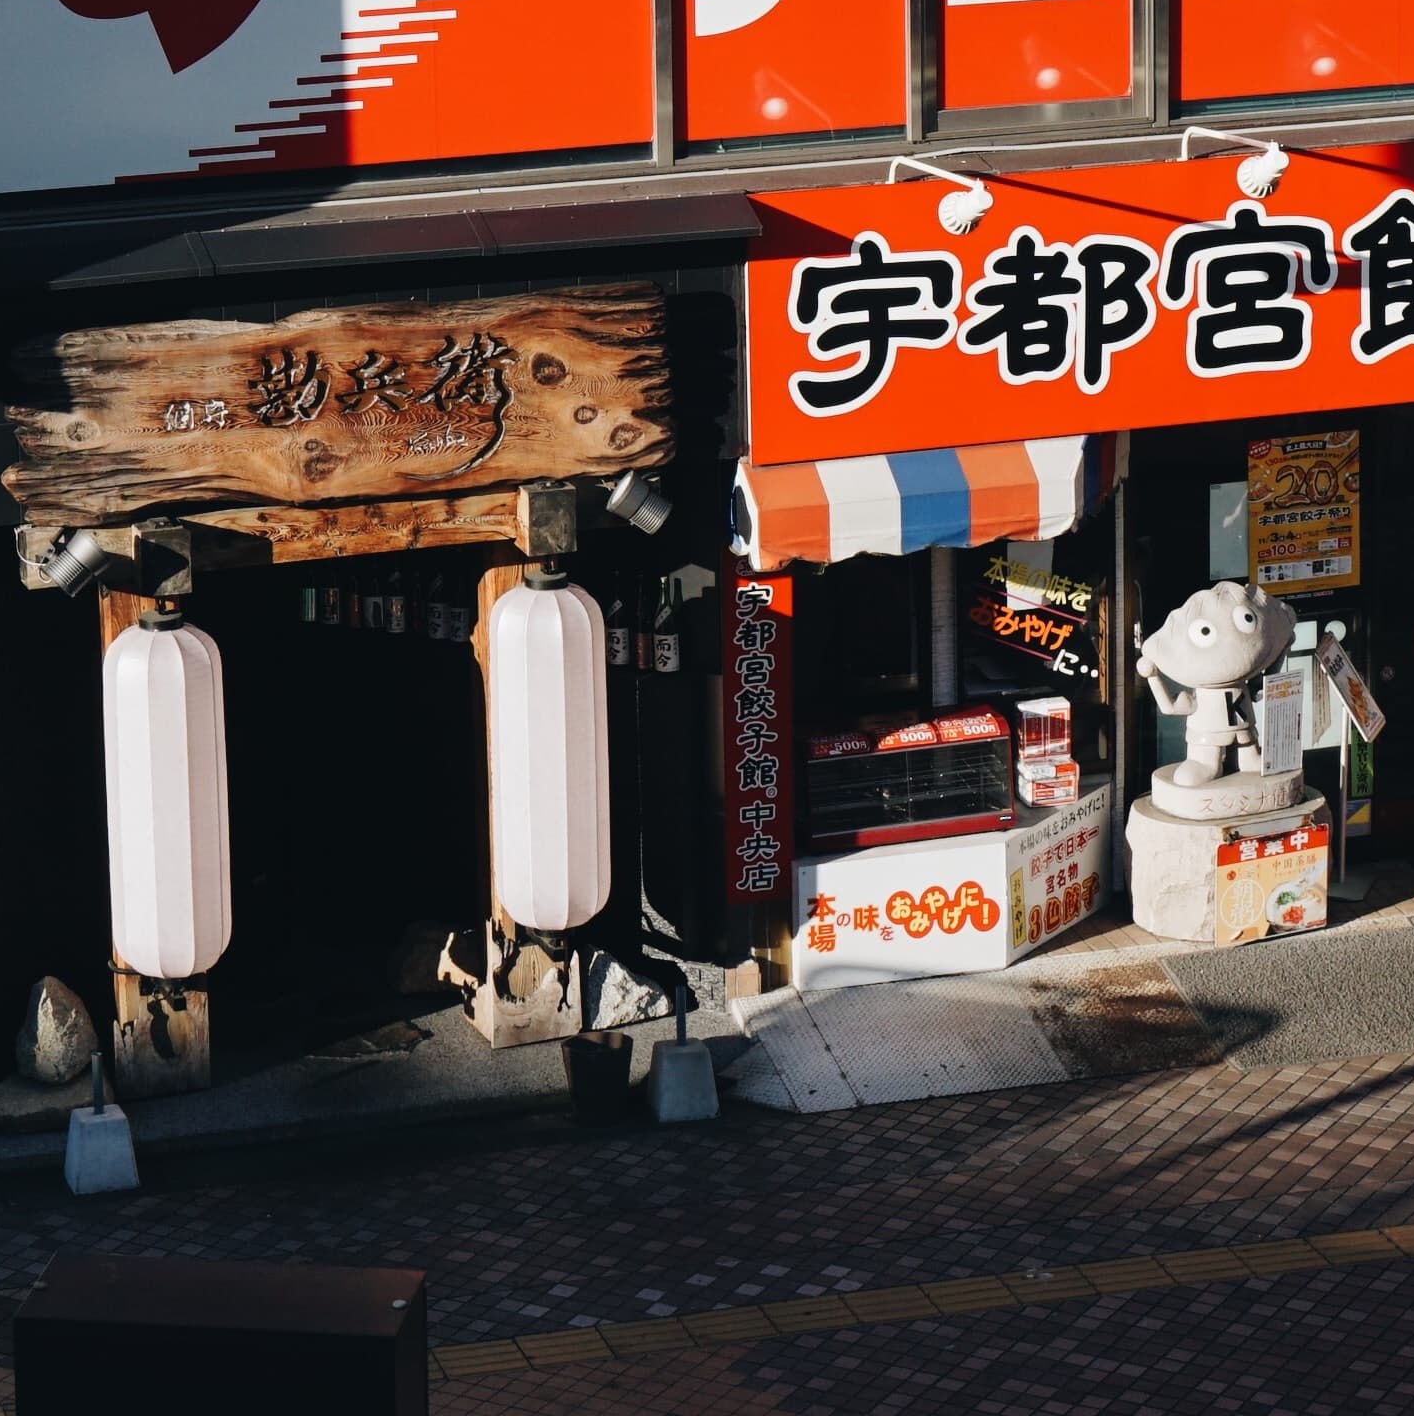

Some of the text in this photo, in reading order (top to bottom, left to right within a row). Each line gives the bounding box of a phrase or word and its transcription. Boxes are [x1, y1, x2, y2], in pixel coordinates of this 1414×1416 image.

[1259, 507, 1351, 526] 宇都宮餃子祭り
[1225, 691, 1248, 727] K
[736, 585, 779, 892] 宇都宮餃子館 中央店
[1239, 830, 1309, 862] 営業中
